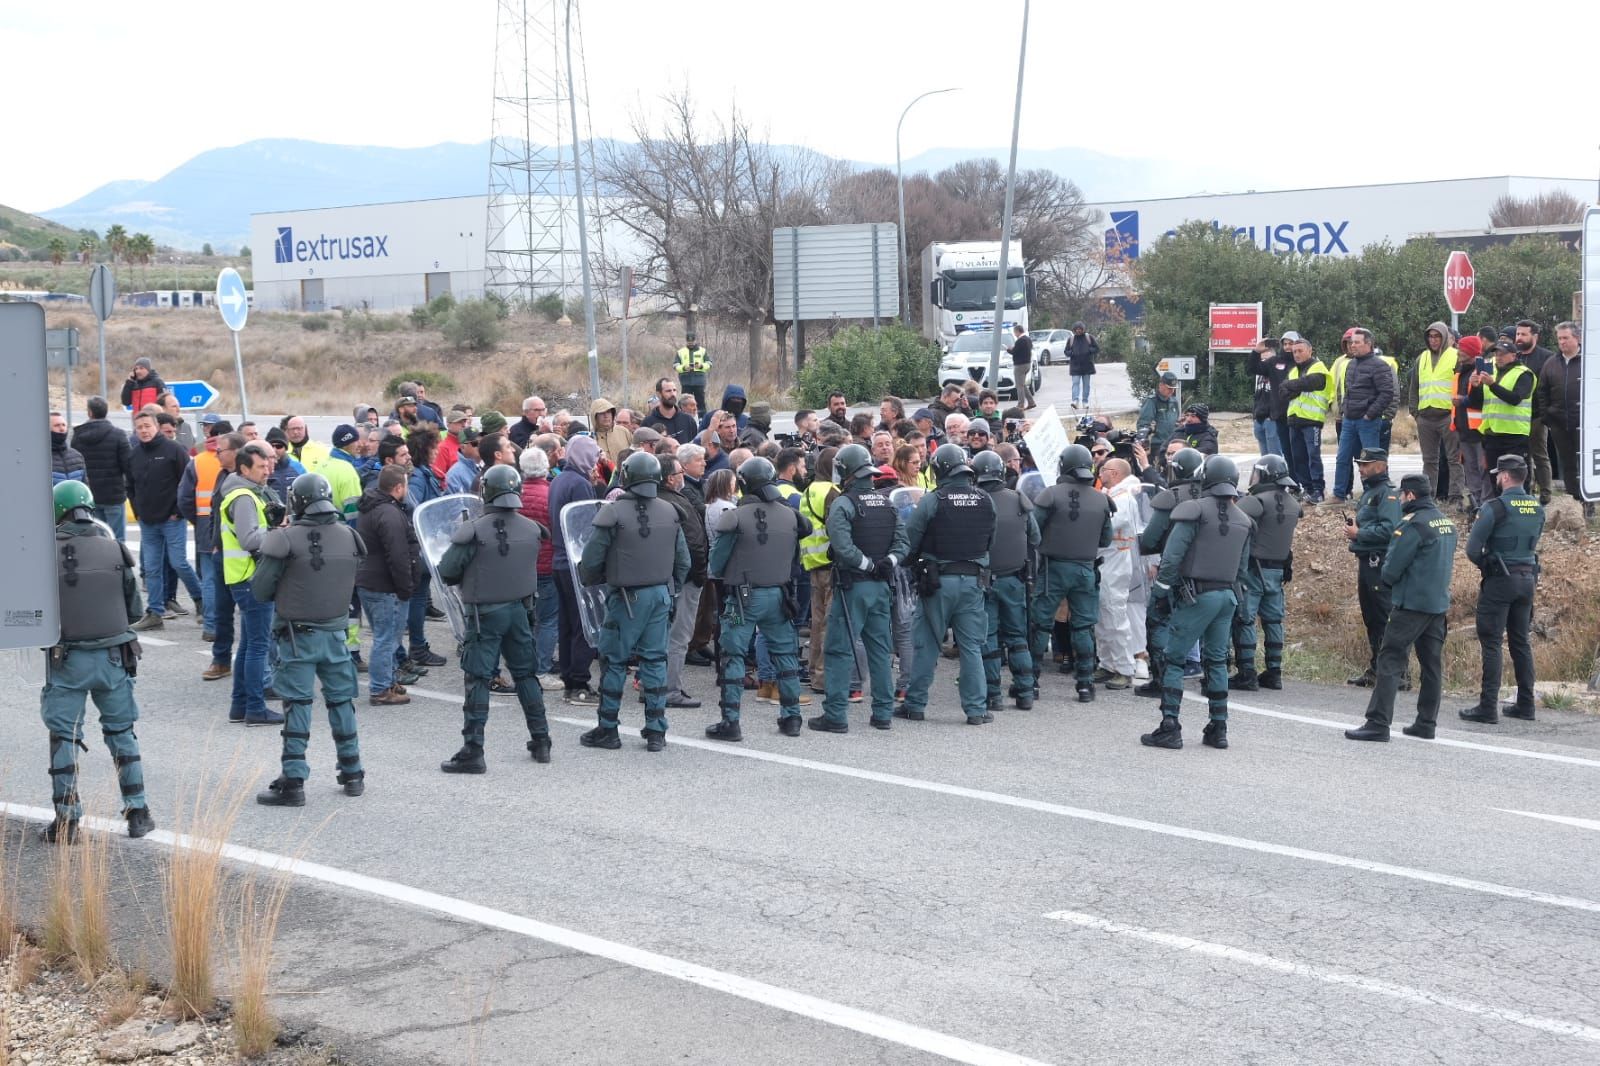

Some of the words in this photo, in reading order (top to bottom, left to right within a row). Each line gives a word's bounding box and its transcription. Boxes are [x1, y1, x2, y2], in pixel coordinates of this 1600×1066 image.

[296, 233, 388, 262] extrusax
[1447, 276, 1473, 290] STOP
[1510, 499, 1540, 507] GUARDIA
